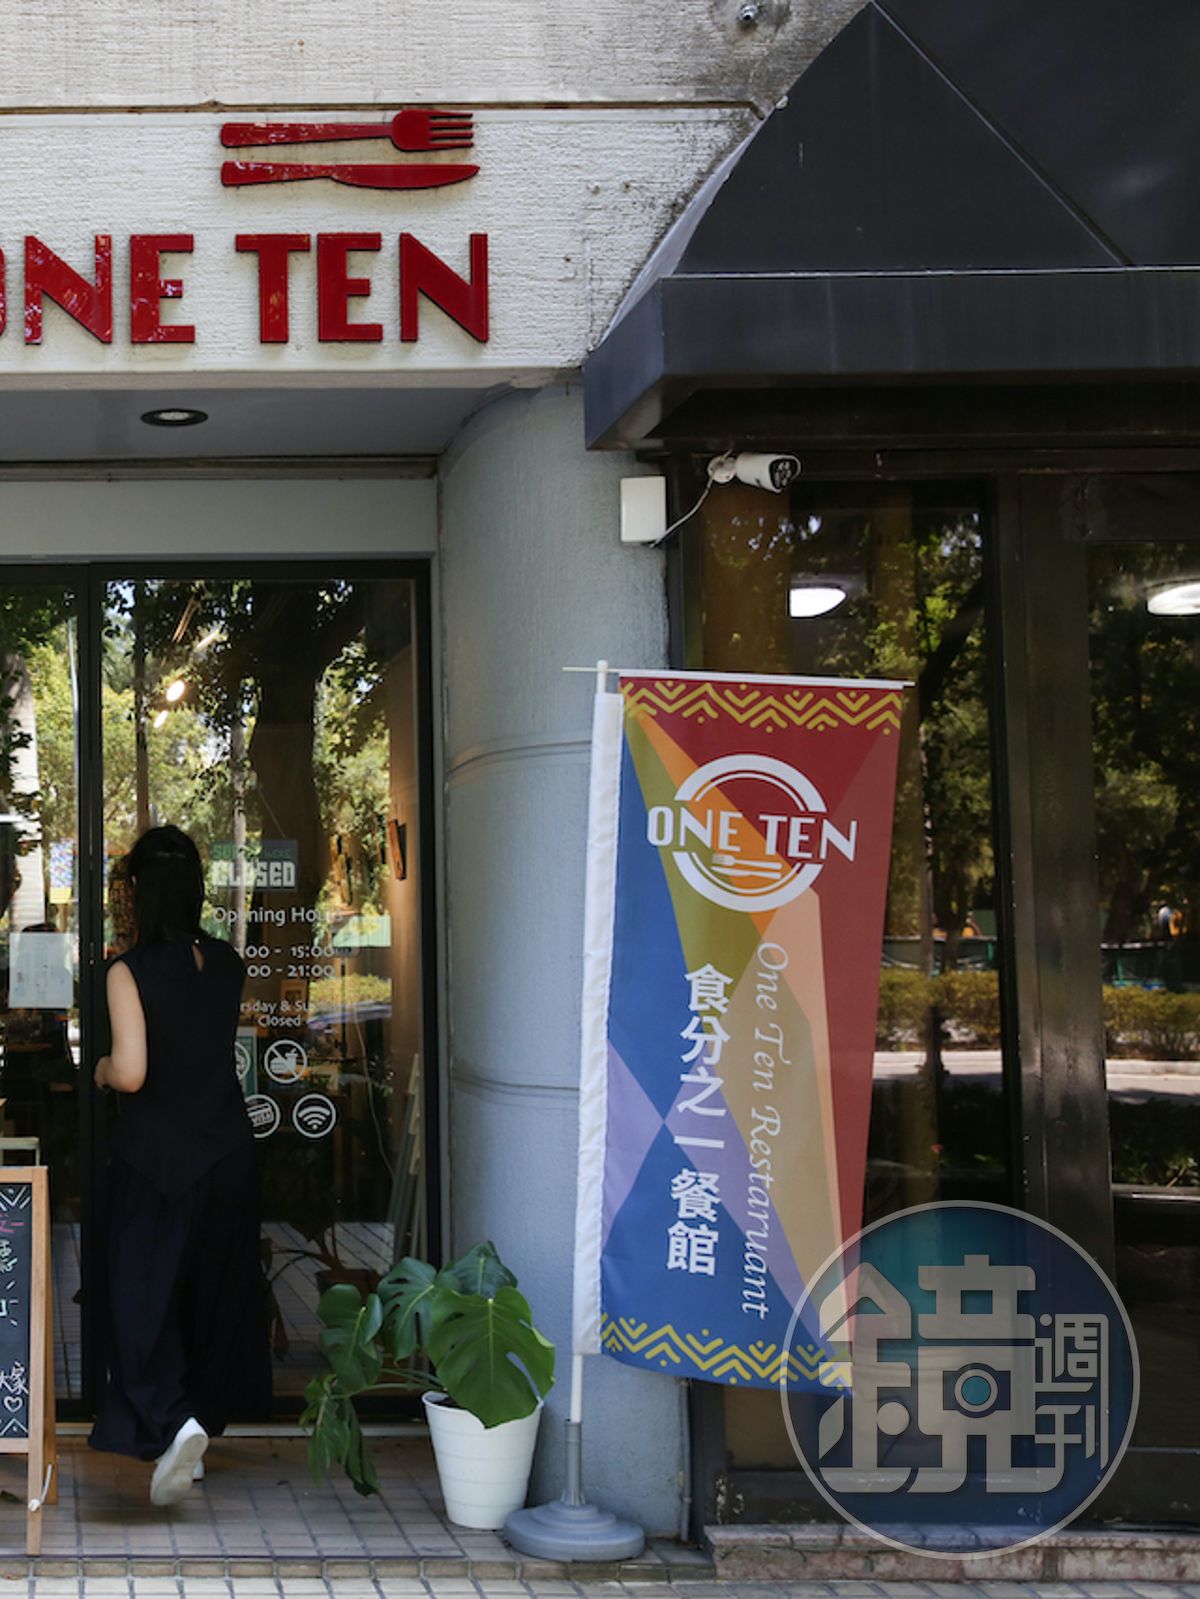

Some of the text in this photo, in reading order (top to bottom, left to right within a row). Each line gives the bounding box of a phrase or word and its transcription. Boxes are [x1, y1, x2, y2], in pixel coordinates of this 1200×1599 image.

[235, 232, 489, 343] TEN
[646, 805, 858, 862] ONE TEN
[213, 907, 286, 927] Opning
[287, 964, 335, 978] 21:00
[290, 945, 334, 959] 15:00
[258, 1015, 301, 1027] Closed
[667, 963, 734, 1276] 食分之一餐館
[741, 942, 792, 1320] One Ten Restaruant
